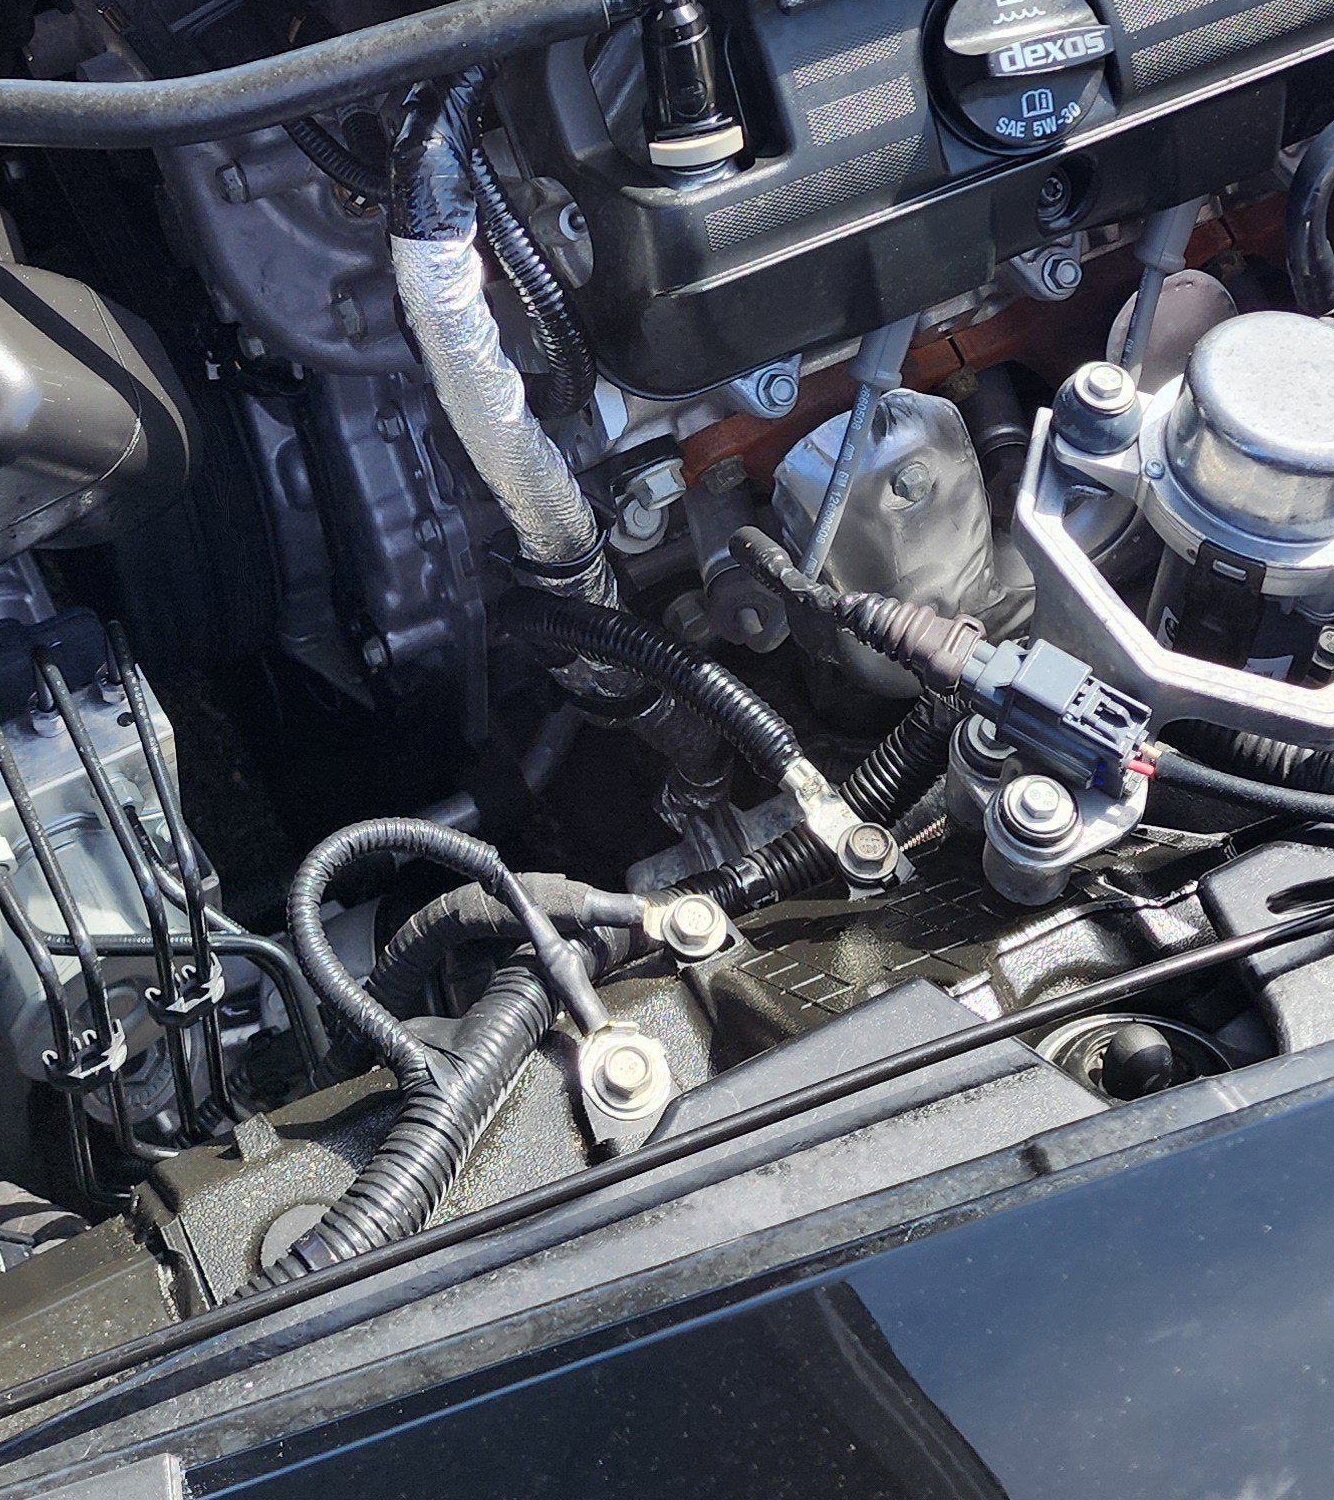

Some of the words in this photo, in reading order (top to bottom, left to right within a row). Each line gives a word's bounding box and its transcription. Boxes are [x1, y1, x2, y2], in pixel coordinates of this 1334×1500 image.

[998, 30, 1106, 73] dexos
[995, 116, 1026, 139] SAE
[1032, 101, 1082, 138] 5W-30
